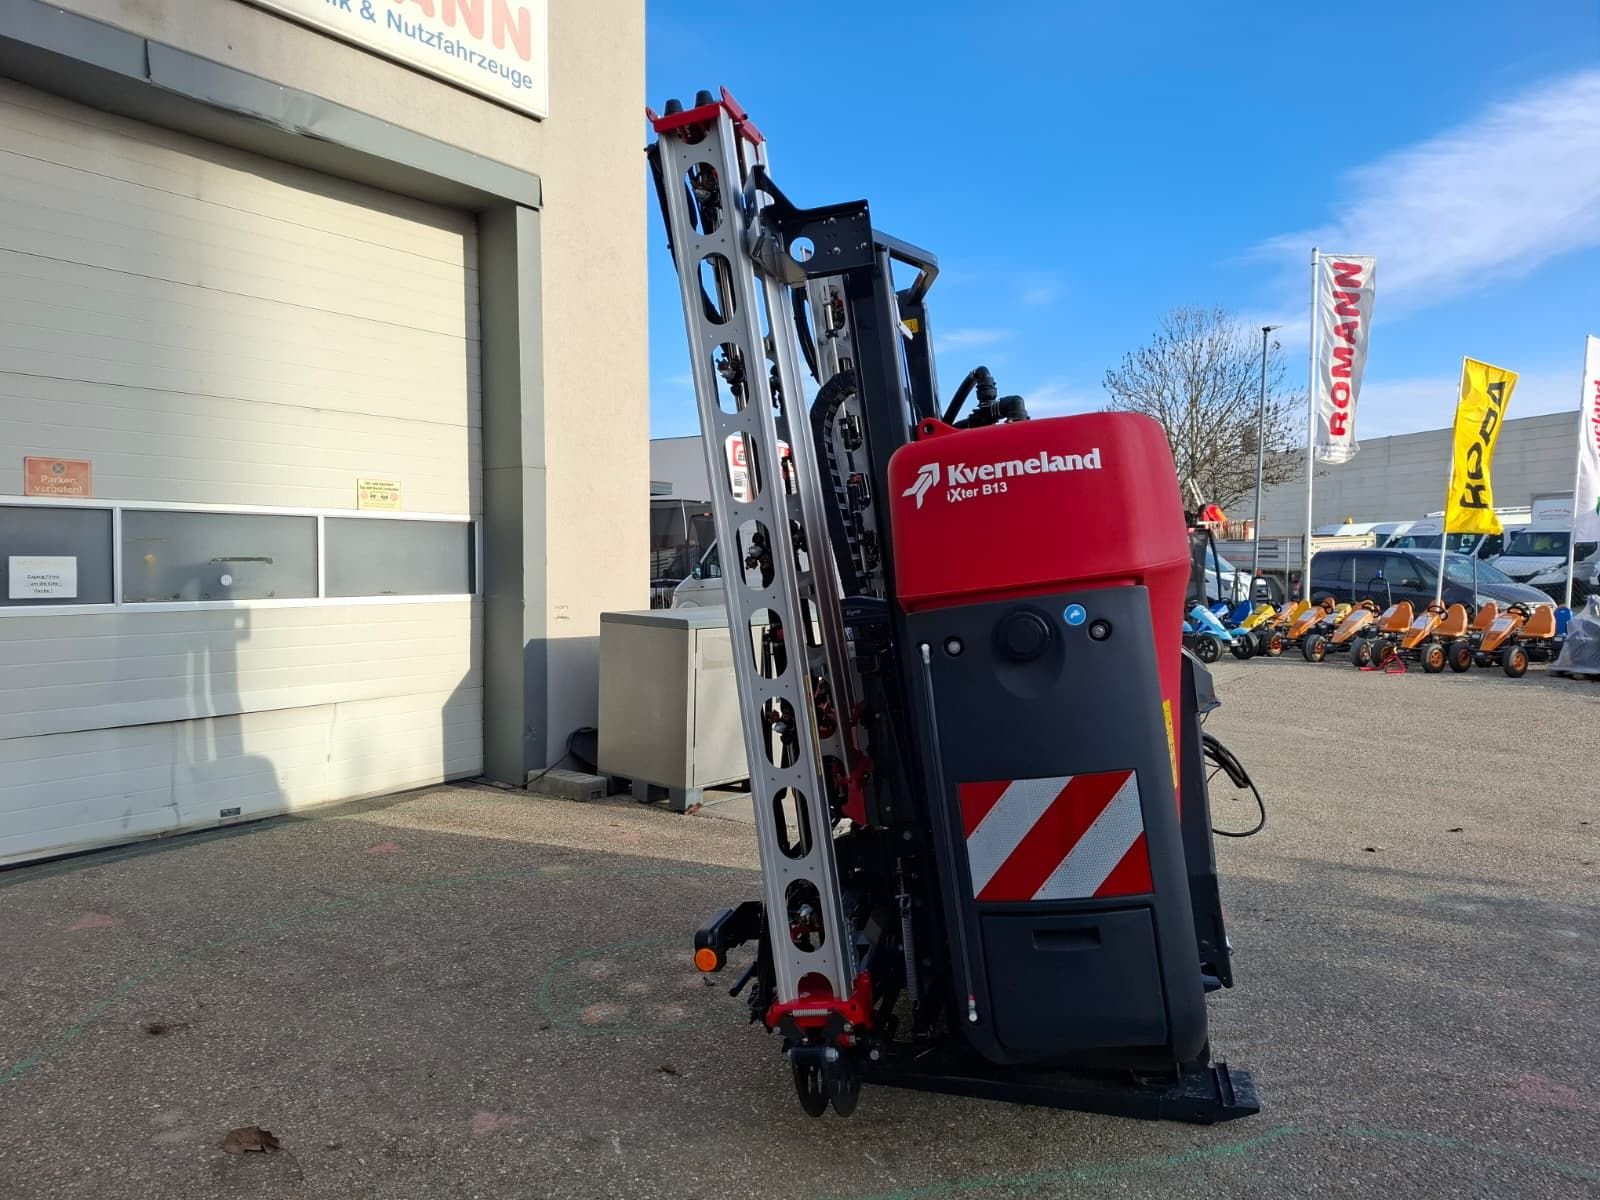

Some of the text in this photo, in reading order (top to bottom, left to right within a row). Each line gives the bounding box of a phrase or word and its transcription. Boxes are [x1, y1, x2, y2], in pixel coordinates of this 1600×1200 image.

[359, 0, 533, 89] & Nutzfahrzeuge
[1330, 262, 1363, 436] ROMANN
[947, 448, 1102, 487] Kverneland
[982, 482, 1008, 496] B13
[1459, 381, 1507, 510] ROPA
